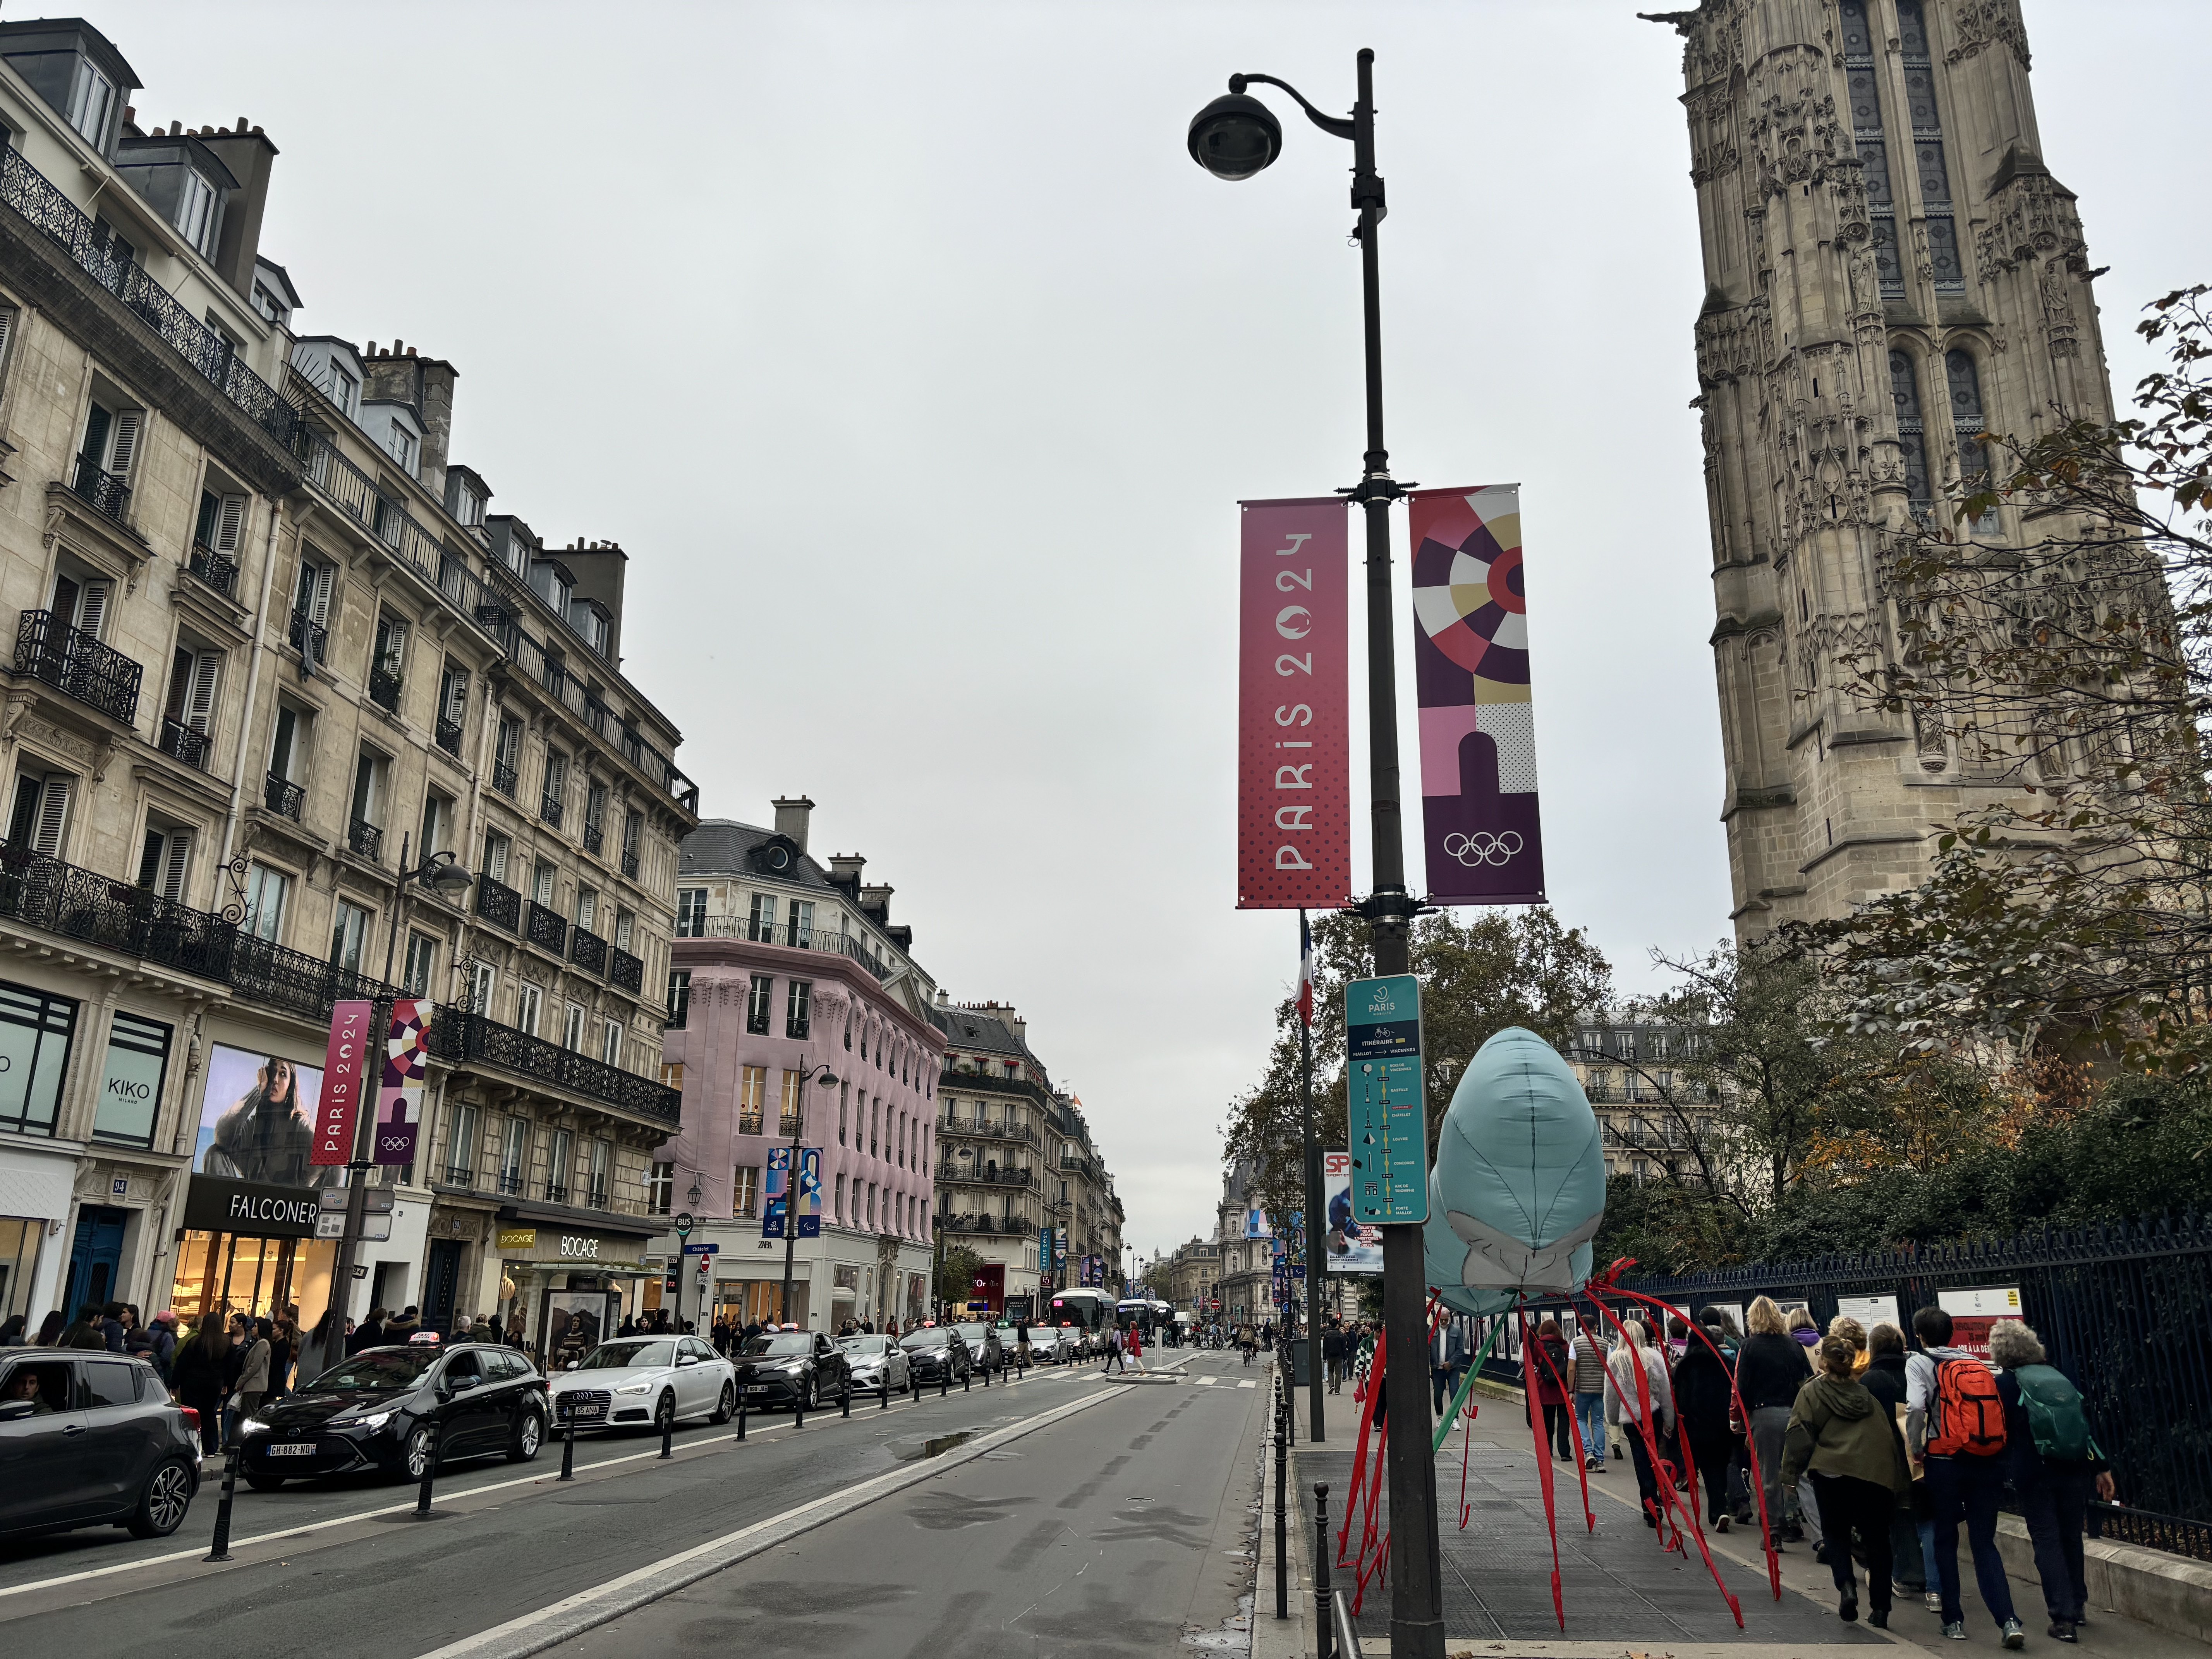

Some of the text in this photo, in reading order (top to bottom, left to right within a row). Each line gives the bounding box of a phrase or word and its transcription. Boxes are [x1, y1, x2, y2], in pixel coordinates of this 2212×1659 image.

[1275, 533, 1312, 677] 2024
[1369, 1002, 1395, 1012] PARIS
[337, 1014, 358, 1073] 2024
[108, 1077, 150, 1099] KIKO
[114, 1181, 124, 1192] 94
[230, 1195, 318, 1224] FALCONER
[501, 1234, 533, 1243] BOCAGE
[561, 1236, 599, 1258] BOCAGE
[758, 1240, 772, 1249] ZARA
[1969, 1343, 1973, 1353] À
[1973, 1345, 1980, 1353] LA
[271, 1445, 310, 1455] GH-882-ND
